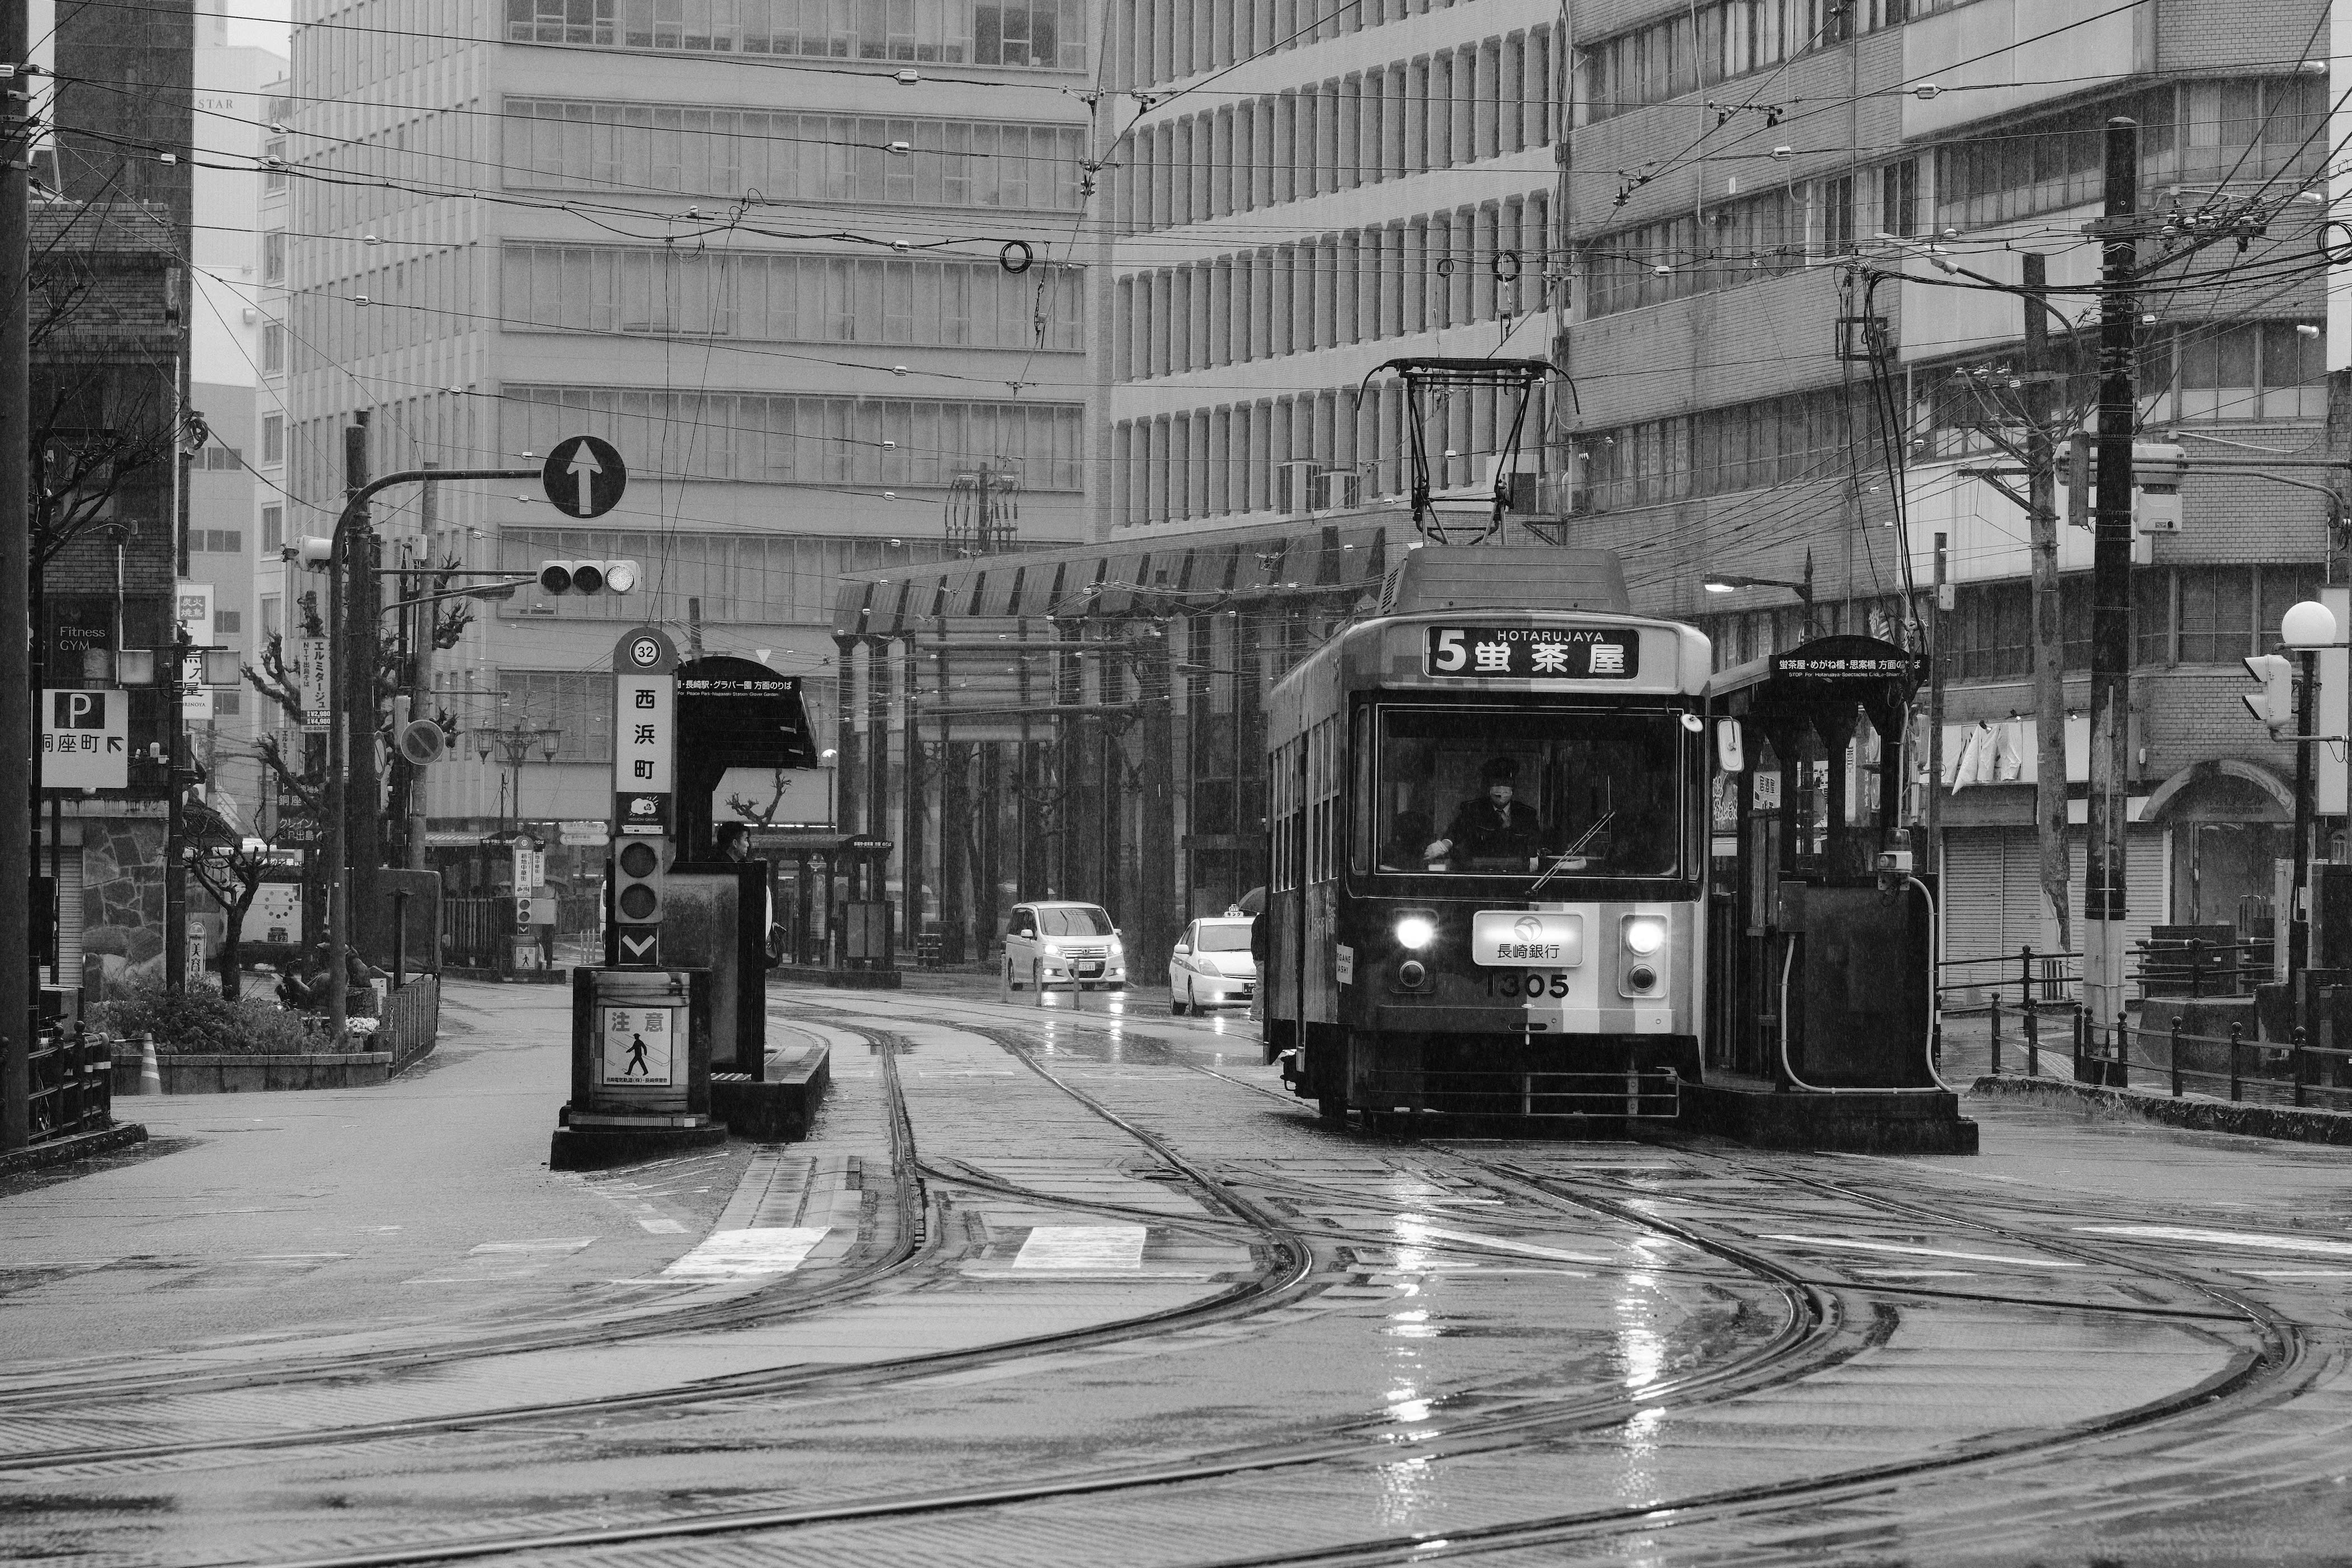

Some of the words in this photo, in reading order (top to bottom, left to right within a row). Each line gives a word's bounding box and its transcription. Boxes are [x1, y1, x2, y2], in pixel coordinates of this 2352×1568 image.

[198, 99, 233, 109] STAR
[181, 598, 204, 606] 炭火
[59, 626, 106, 637] Fitness
[1497, 630, 1604, 642] HOTARUJAYA
[59, 640, 90, 651] GYM
[638, 646, 654, 657] 32
[1436, 629, 1467, 671] 5
[1474, 641, 1625, 674] 蛍茶屋
[314, 641, 326, 708] エルミタージュ
[754, 681, 792, 690] 方面のりば
[69, 693, 92, 729] P
[634, 689, 656, 780] 西浜町
[1497, 944, 1560, 959] 長崎銀行
[1337, 965, 1348, 974] ASHI
[1486, 973, 1570, 999] 1305
[612, 1011, 664, 1032] 注意
